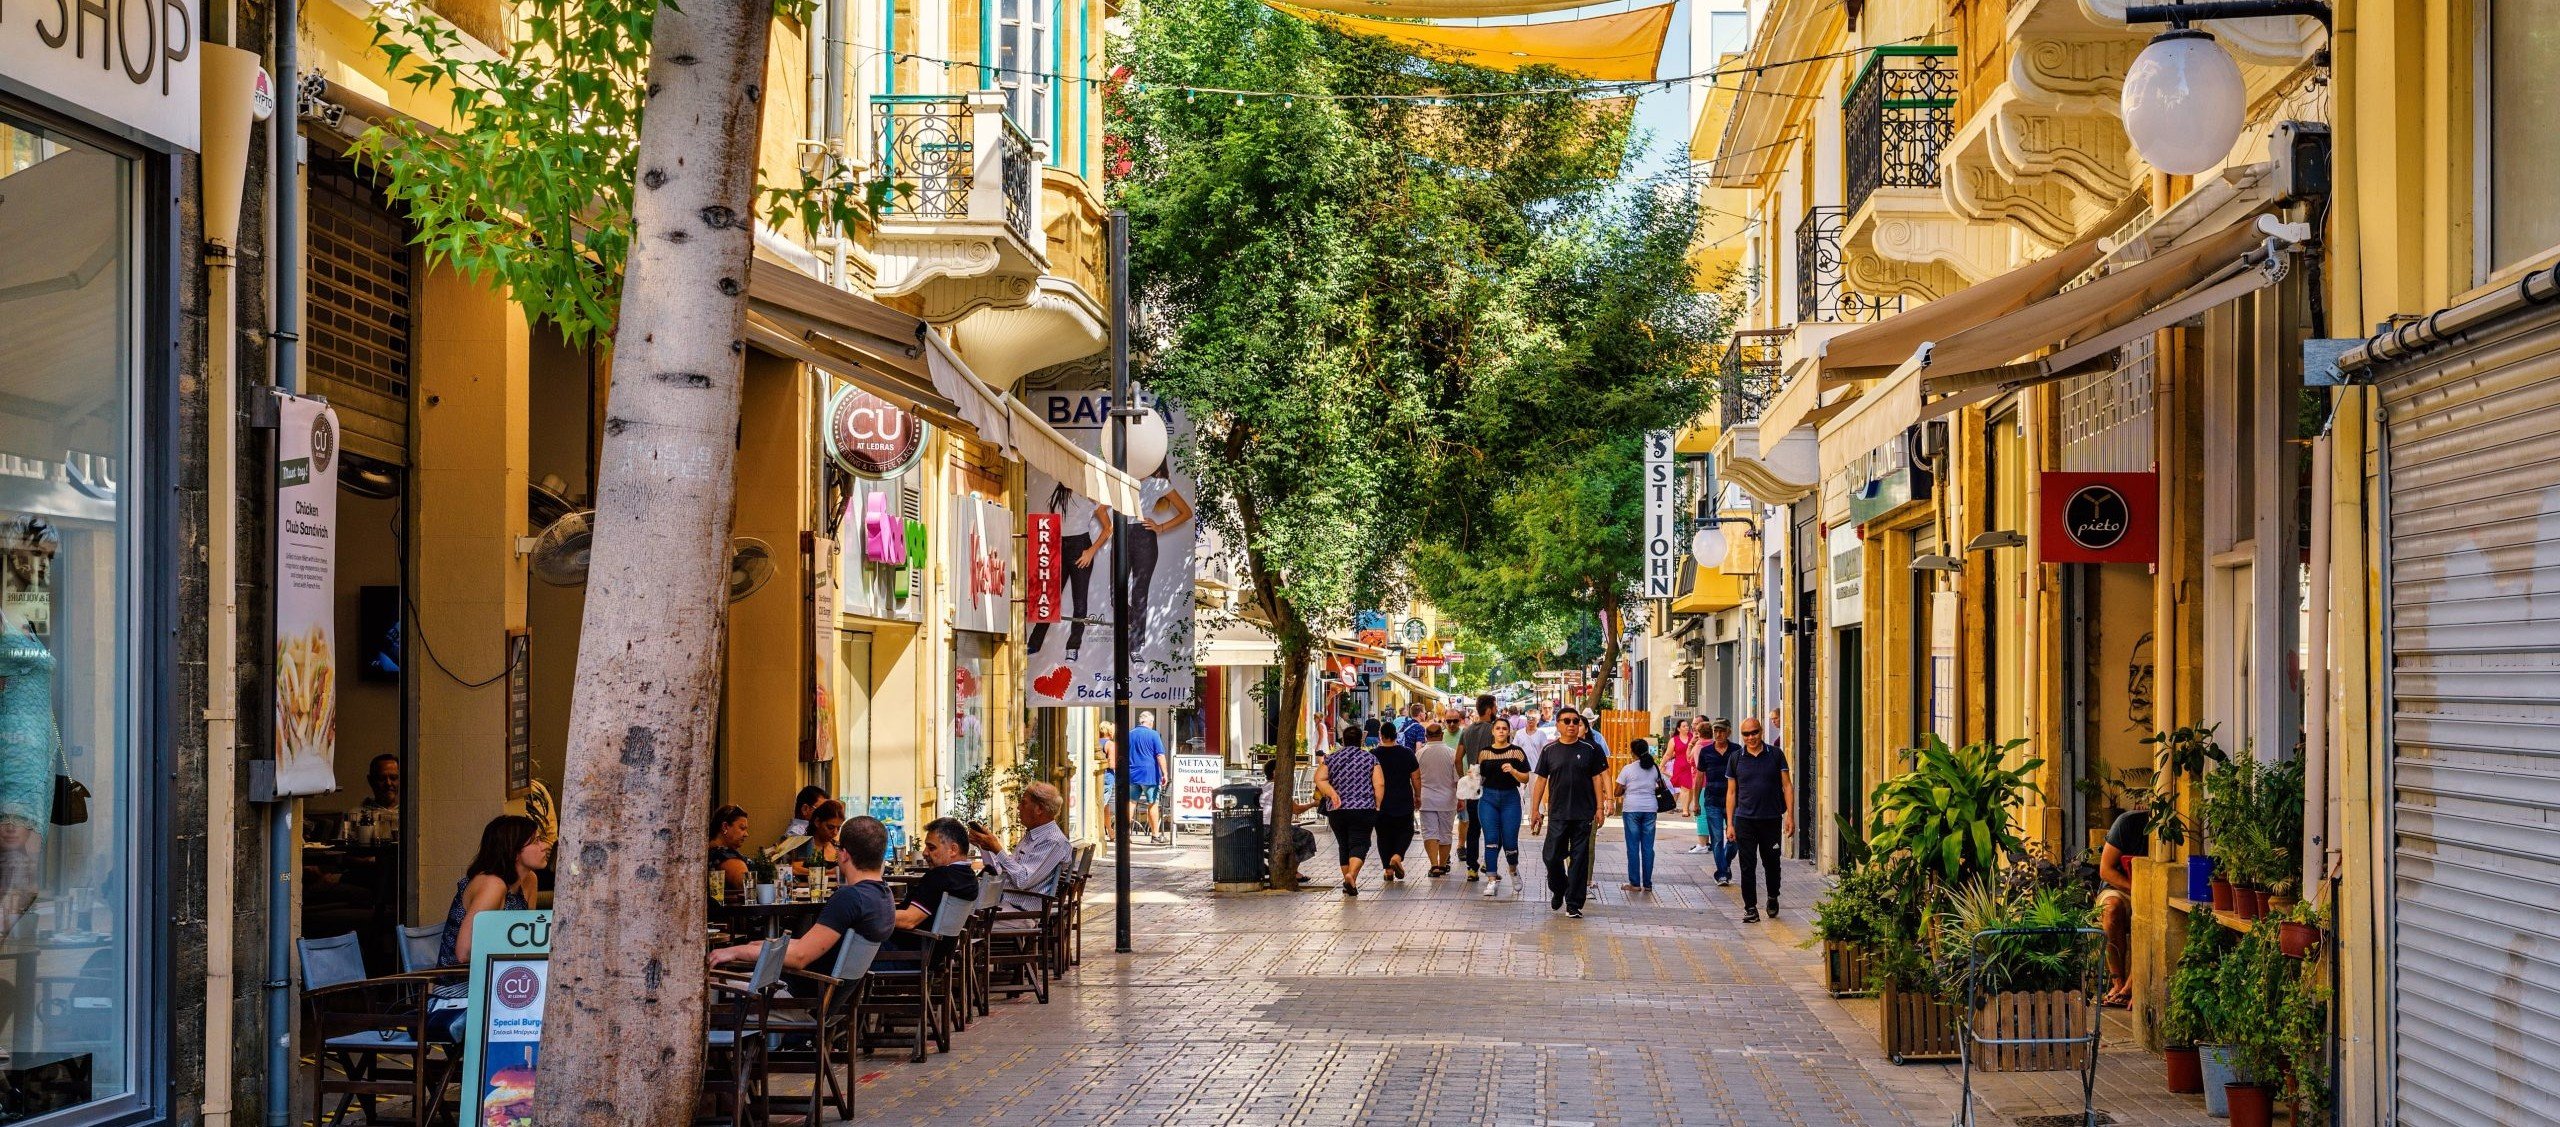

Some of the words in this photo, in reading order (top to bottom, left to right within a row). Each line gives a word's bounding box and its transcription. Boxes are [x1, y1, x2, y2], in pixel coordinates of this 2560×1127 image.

[36, 0, 191, 96] SHOP
[857, 442, 864, 450] AT
[866, 442, 895, 451] LEDRAS
[837, 441, 861, 468] MEETING
[869, 461, 897, 473] COFFEE
[896, 444, 916, 466] PLACE
[295, 500, 319, 517] Chicken
[285, 519, 299, 534] Club
[299, 521, 329, 539] Sandwich
[2077, 518, 2120, 537] pieto
[1037, 518, 1051, 619] KRASHIAS
[1137, 673, 1169, 683] School
[1077, 685, 1112, 698] Back
[1688, 671, 1697, 705] bamboo
[1178, 759, 1219, 767] METAXA
[1188, 776, 1206, 784] ALL
[507, 922, 551, 948] CU
[505, 978, 531, 995] CU
[493, 1018, 520, 1028] Special
